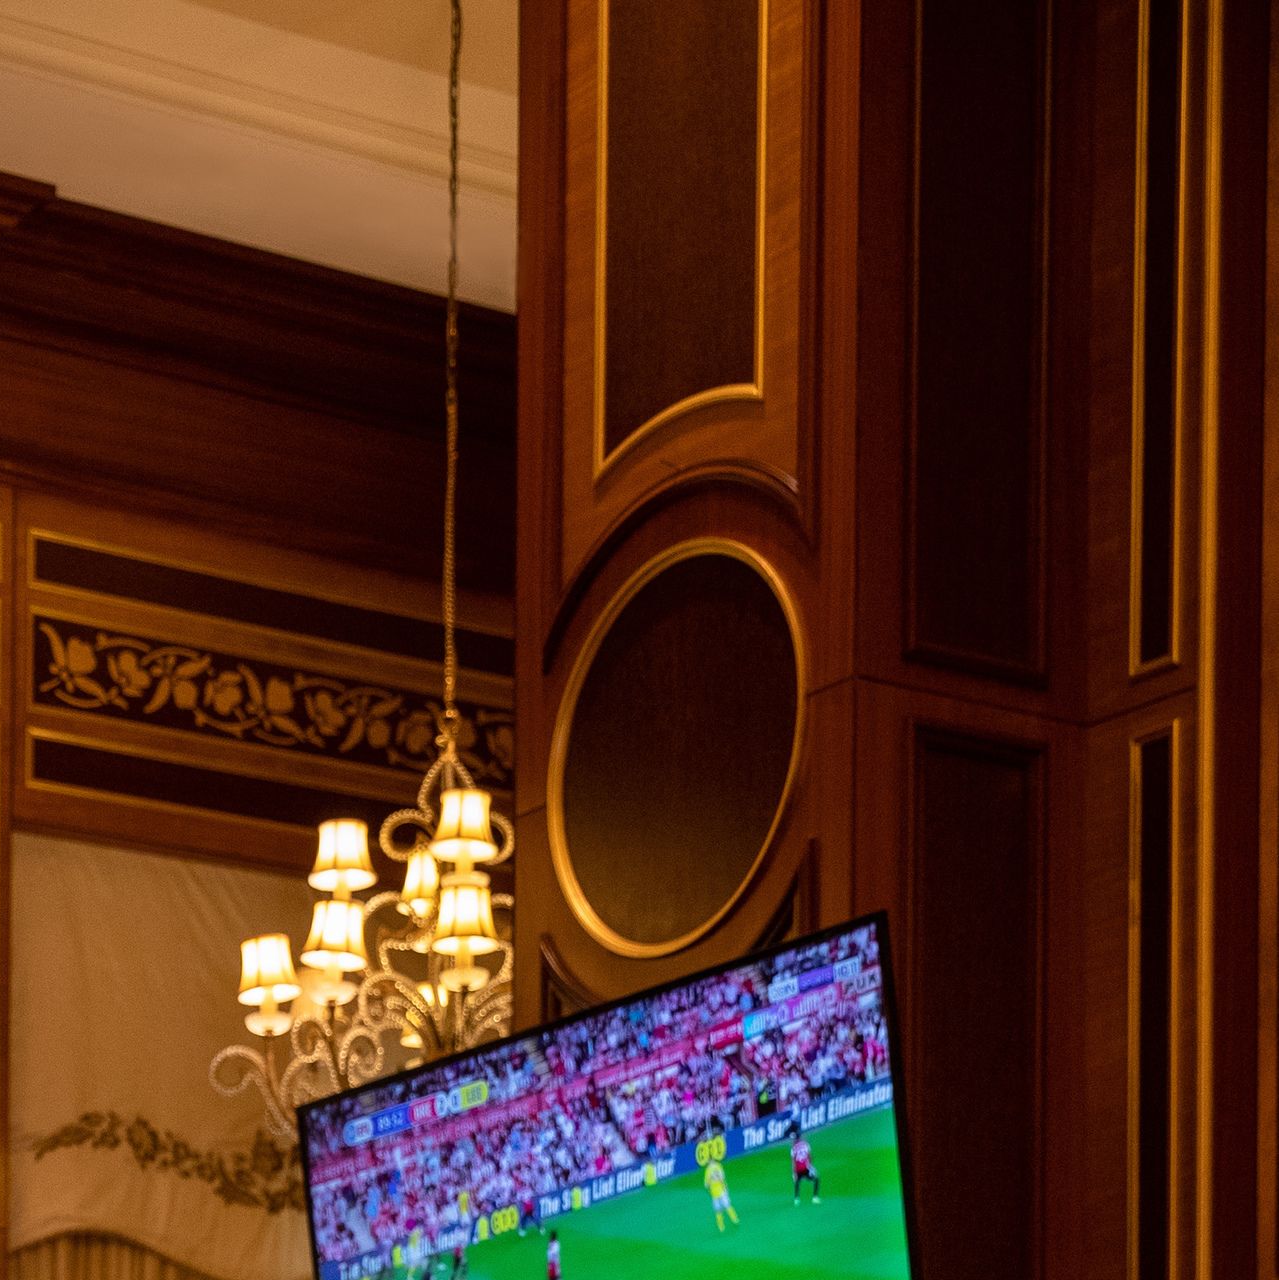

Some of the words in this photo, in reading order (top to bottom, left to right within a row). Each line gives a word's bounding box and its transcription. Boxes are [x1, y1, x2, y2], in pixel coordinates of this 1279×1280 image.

[743, 1125, 765, 1150] The
[801, 1103, 826, 1130] List
[827, 1082, 893, 1120] Eliminator
